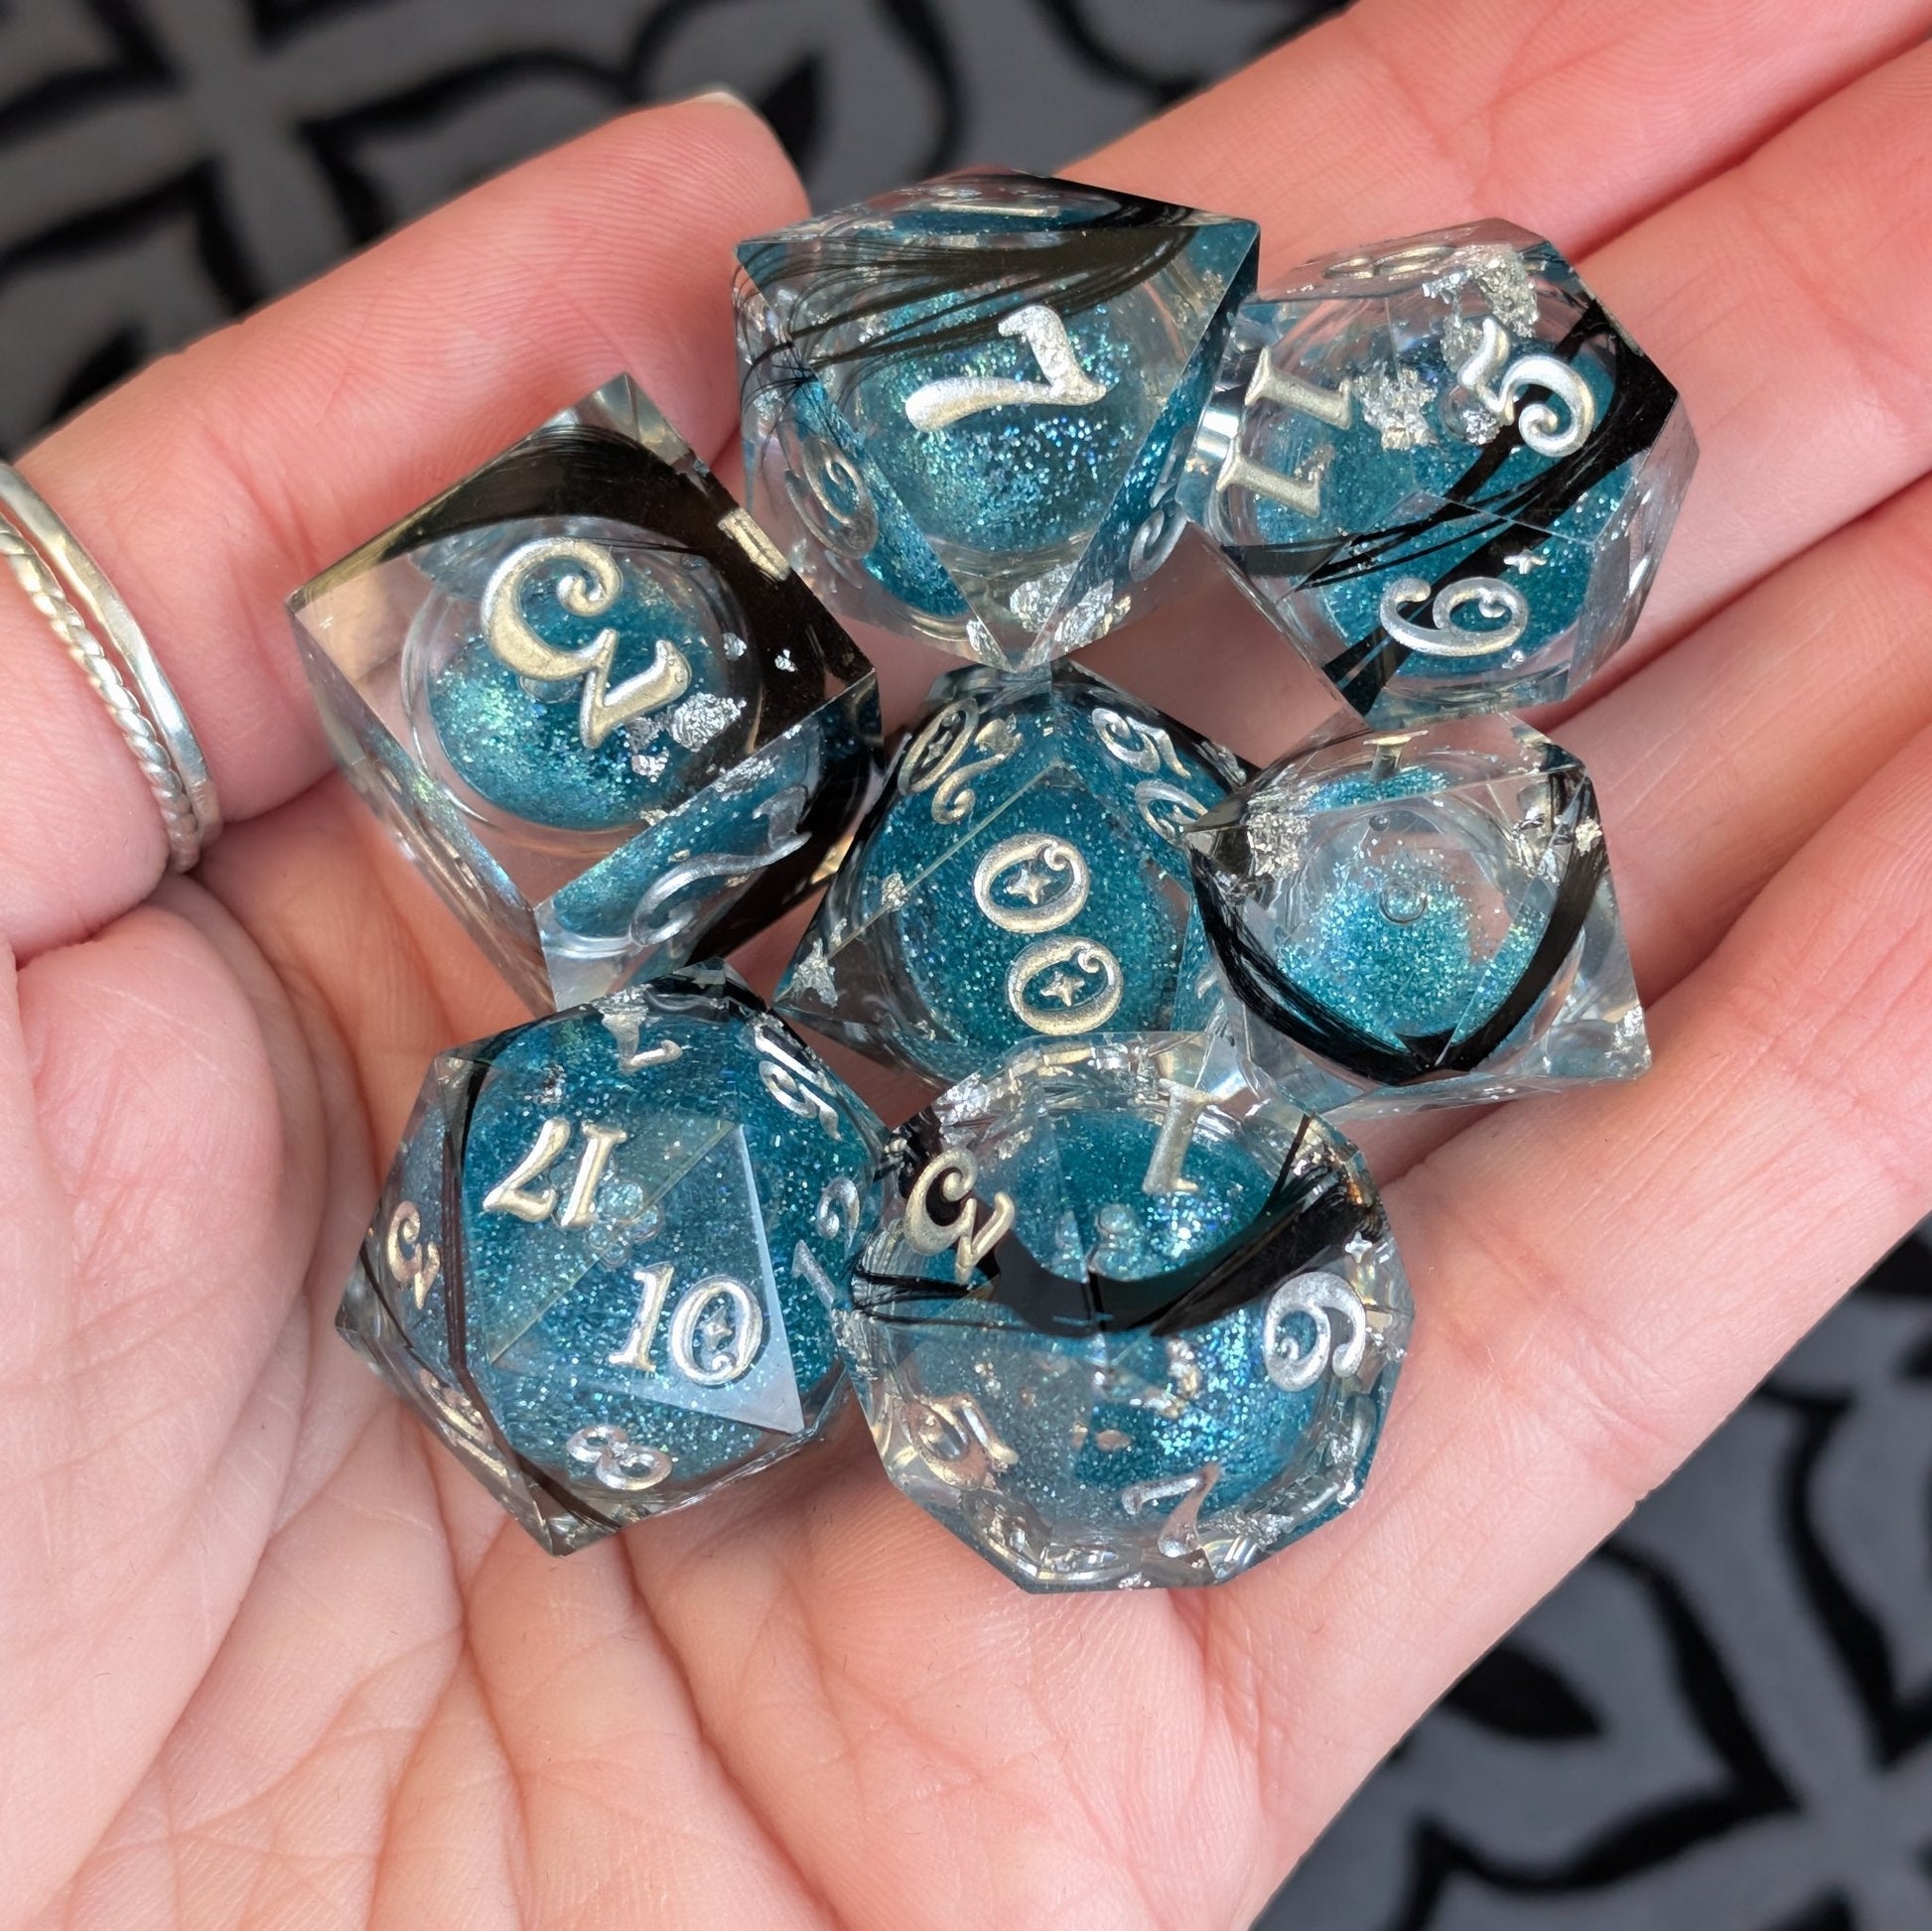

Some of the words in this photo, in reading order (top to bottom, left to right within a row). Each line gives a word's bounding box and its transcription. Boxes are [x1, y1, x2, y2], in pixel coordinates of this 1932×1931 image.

[904, 305, 1107, 433] 7
[1457, 314, 1596, 458] 5
[481, 536, 692, 750] 3
[482, 1117, 627, 1228] 17
[904, 1148, 1016, 1284] 3
[385, 1200, 442, 1310] 3
[609, 1261, 763, 1388] 10
[565, 1424, 673, 1490] 8
